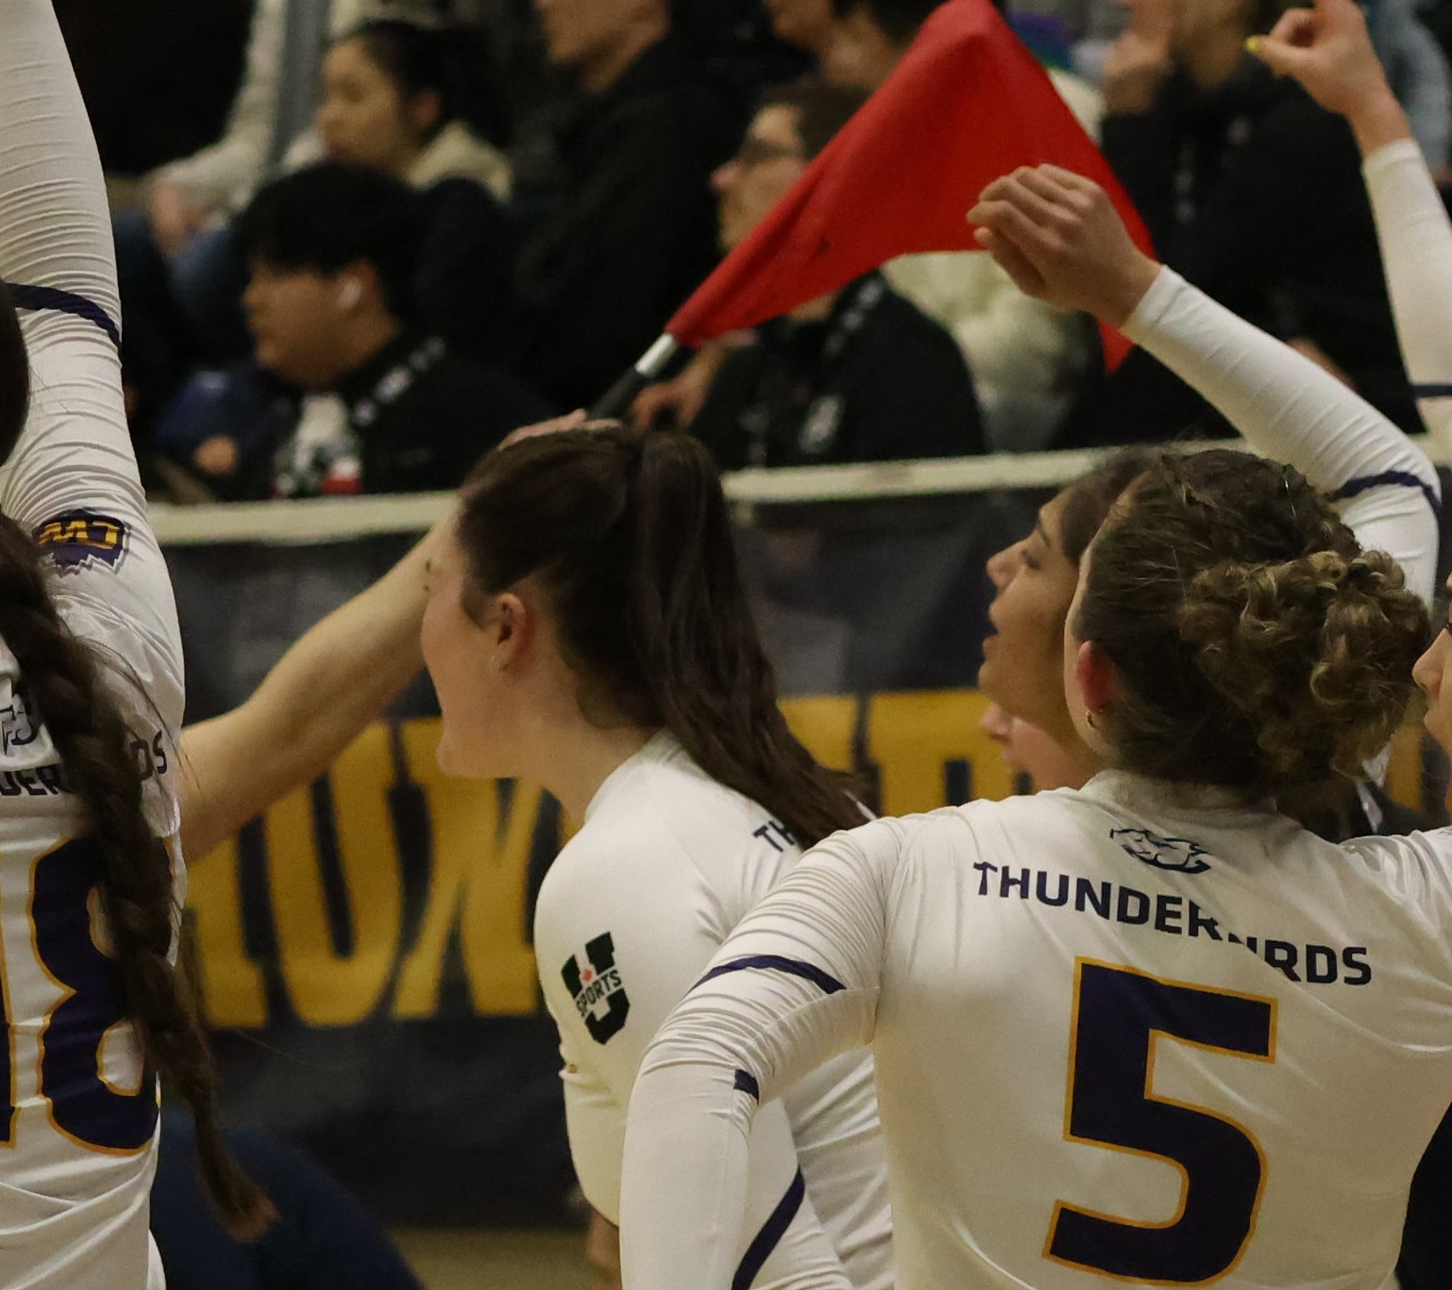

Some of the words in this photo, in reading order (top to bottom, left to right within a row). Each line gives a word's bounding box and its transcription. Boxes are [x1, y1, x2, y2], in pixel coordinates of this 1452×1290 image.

[973, 860, 1372, 985] THUNDERRDS
[576, 969, 622, 1017] SPORTS
[1041, 955, 1279, 1288] 5
